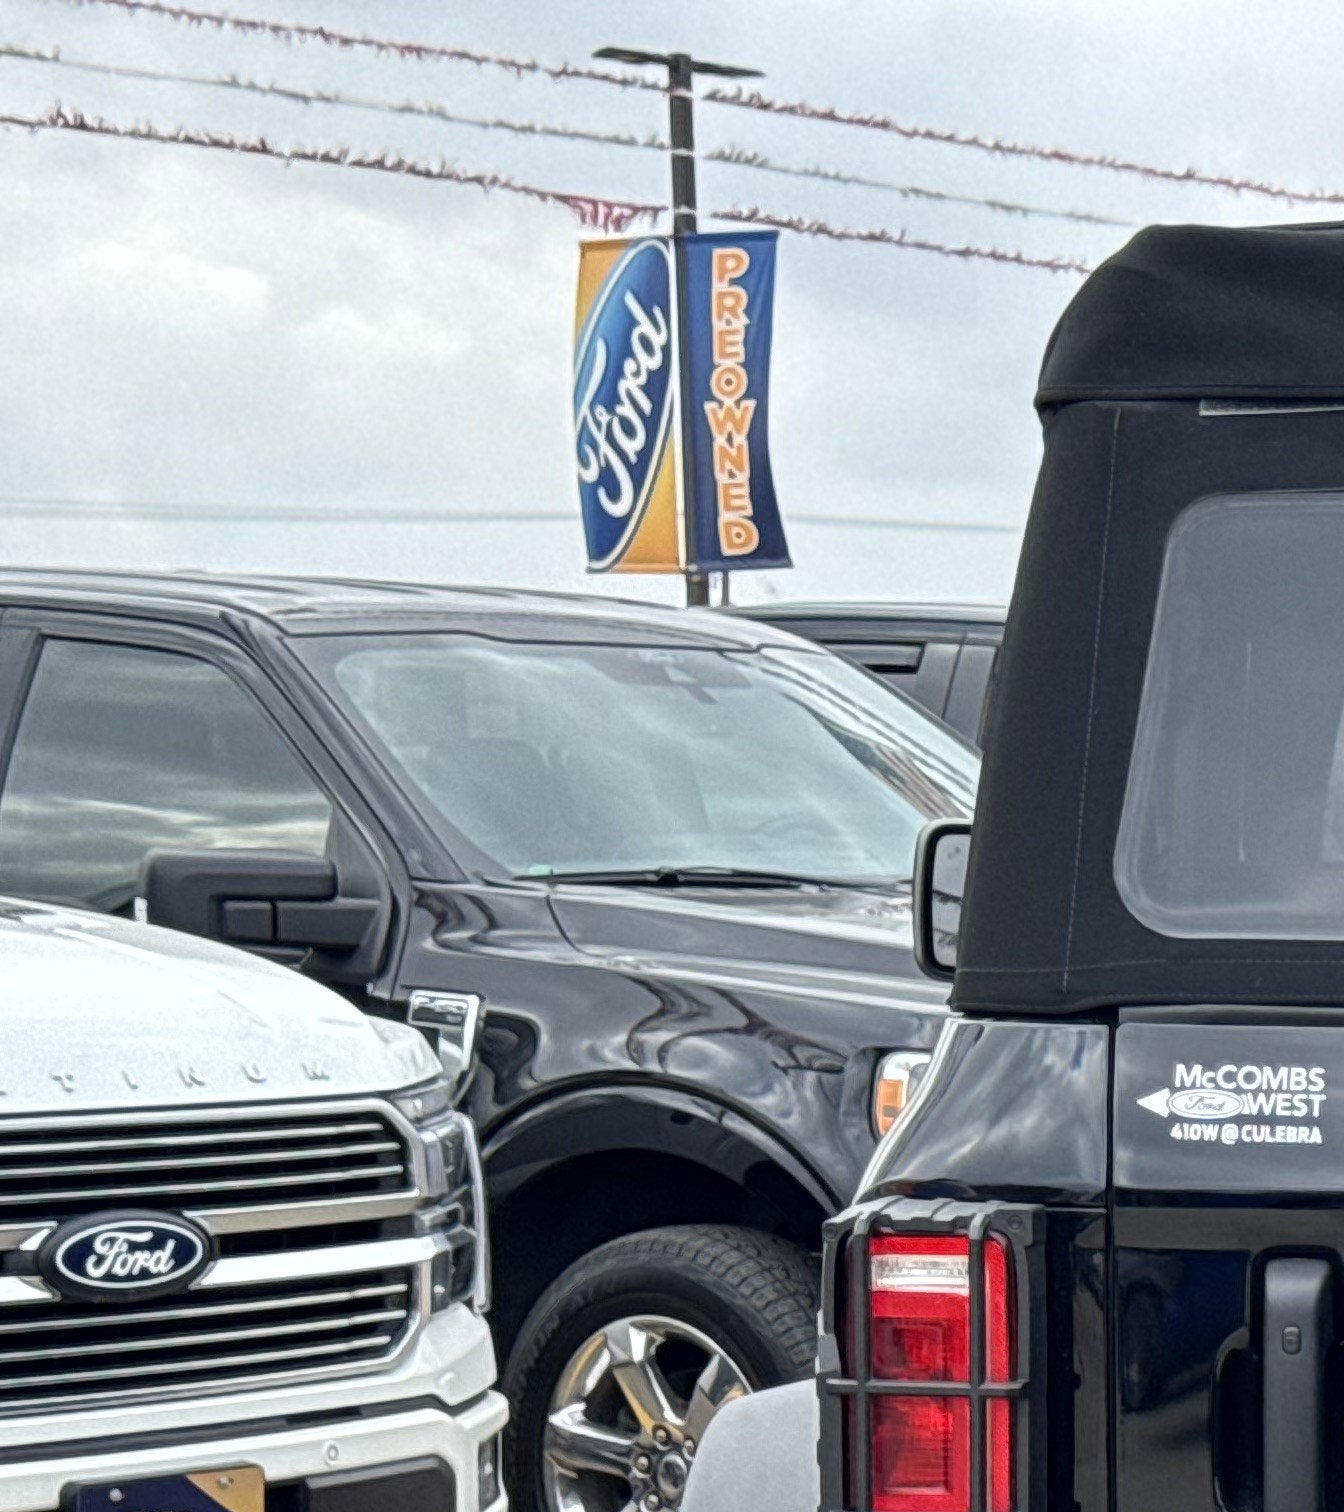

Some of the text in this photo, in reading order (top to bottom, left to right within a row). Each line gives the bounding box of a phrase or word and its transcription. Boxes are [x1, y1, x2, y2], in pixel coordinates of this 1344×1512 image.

[577, 290, 667, 519] Ford
[1174, 1063, 1327, 1092] McCOMBS
[1185, 1096, 1226, 1112] Ford
[1241, 1093, 1327, 1118] WEST
[1170, 1123, 1219, 1141] 410W
[1241, 1125, 1323, 1144] CULEBRA
[85, 1230, 176, 1277] Ford
